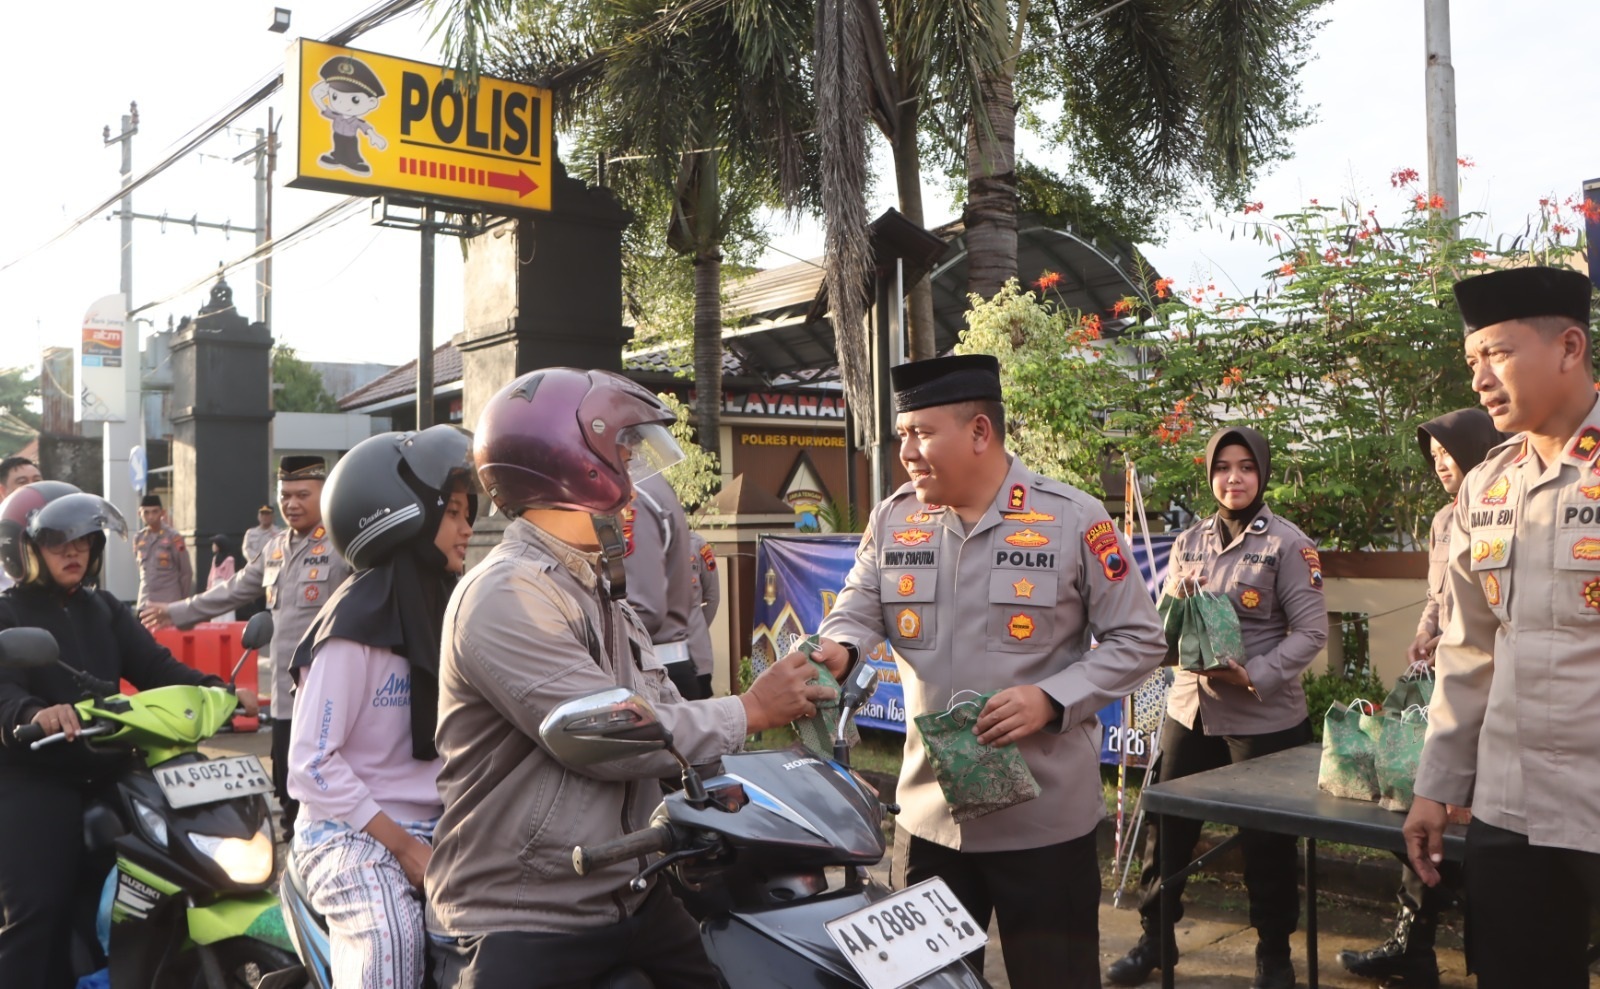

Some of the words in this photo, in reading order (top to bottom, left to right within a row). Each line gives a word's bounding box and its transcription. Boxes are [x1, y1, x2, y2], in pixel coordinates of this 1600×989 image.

[401, 71, 541, 158] POLISI
[93, 329, 121, 341] atm
[688, 389, 845, 417] LAYANA
[742, 434, 787, 446] POLRES
[304, 555, 329, 566] POLRI
[996, 551, 1055, 568] POLRI
[1243, 553, 1277, 567] POLRI
[163, 770, 187, 787] AA
[188, 763, 232, 781] 6052
[236, 760, 260, 774] TL
[121, 874, 160, 900] SUZUKI
[838, 923, 877, 956] AA
[868, 901, 926, 941] 2886
[922, 889, 958, 917] TL
